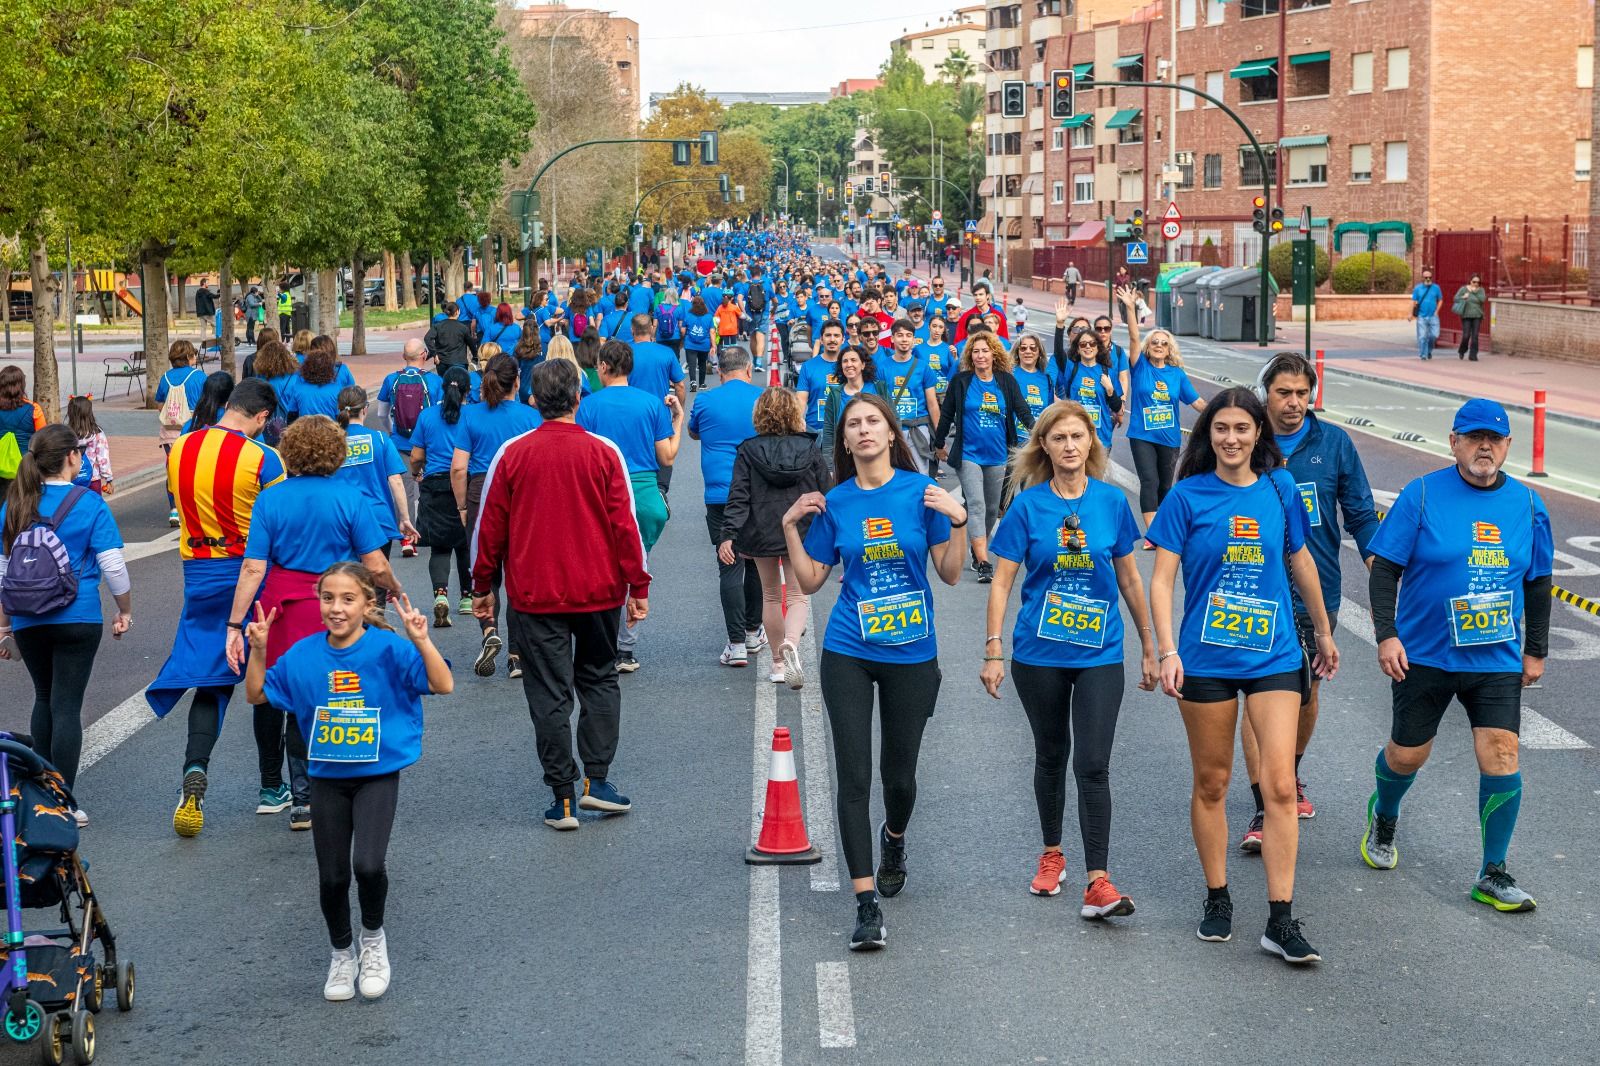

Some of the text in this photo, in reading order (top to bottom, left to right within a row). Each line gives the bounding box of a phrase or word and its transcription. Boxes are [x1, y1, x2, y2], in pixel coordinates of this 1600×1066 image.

[1148, 412, 1171, 422] 1484
[869, 550, 904, 561] VALENCIA
[1229, 553, 1264, 563] VALENCIA
[1474, 556, 1510, 566] VALENCIA
[867, 608, 922, 634] 2214
[1047, 608, 1101, 632] 2654
[1211, 611, 1269, 635] 2213
[1460, 610, 1508, 630] 2073
[317, 726, 374, 744] 3054
